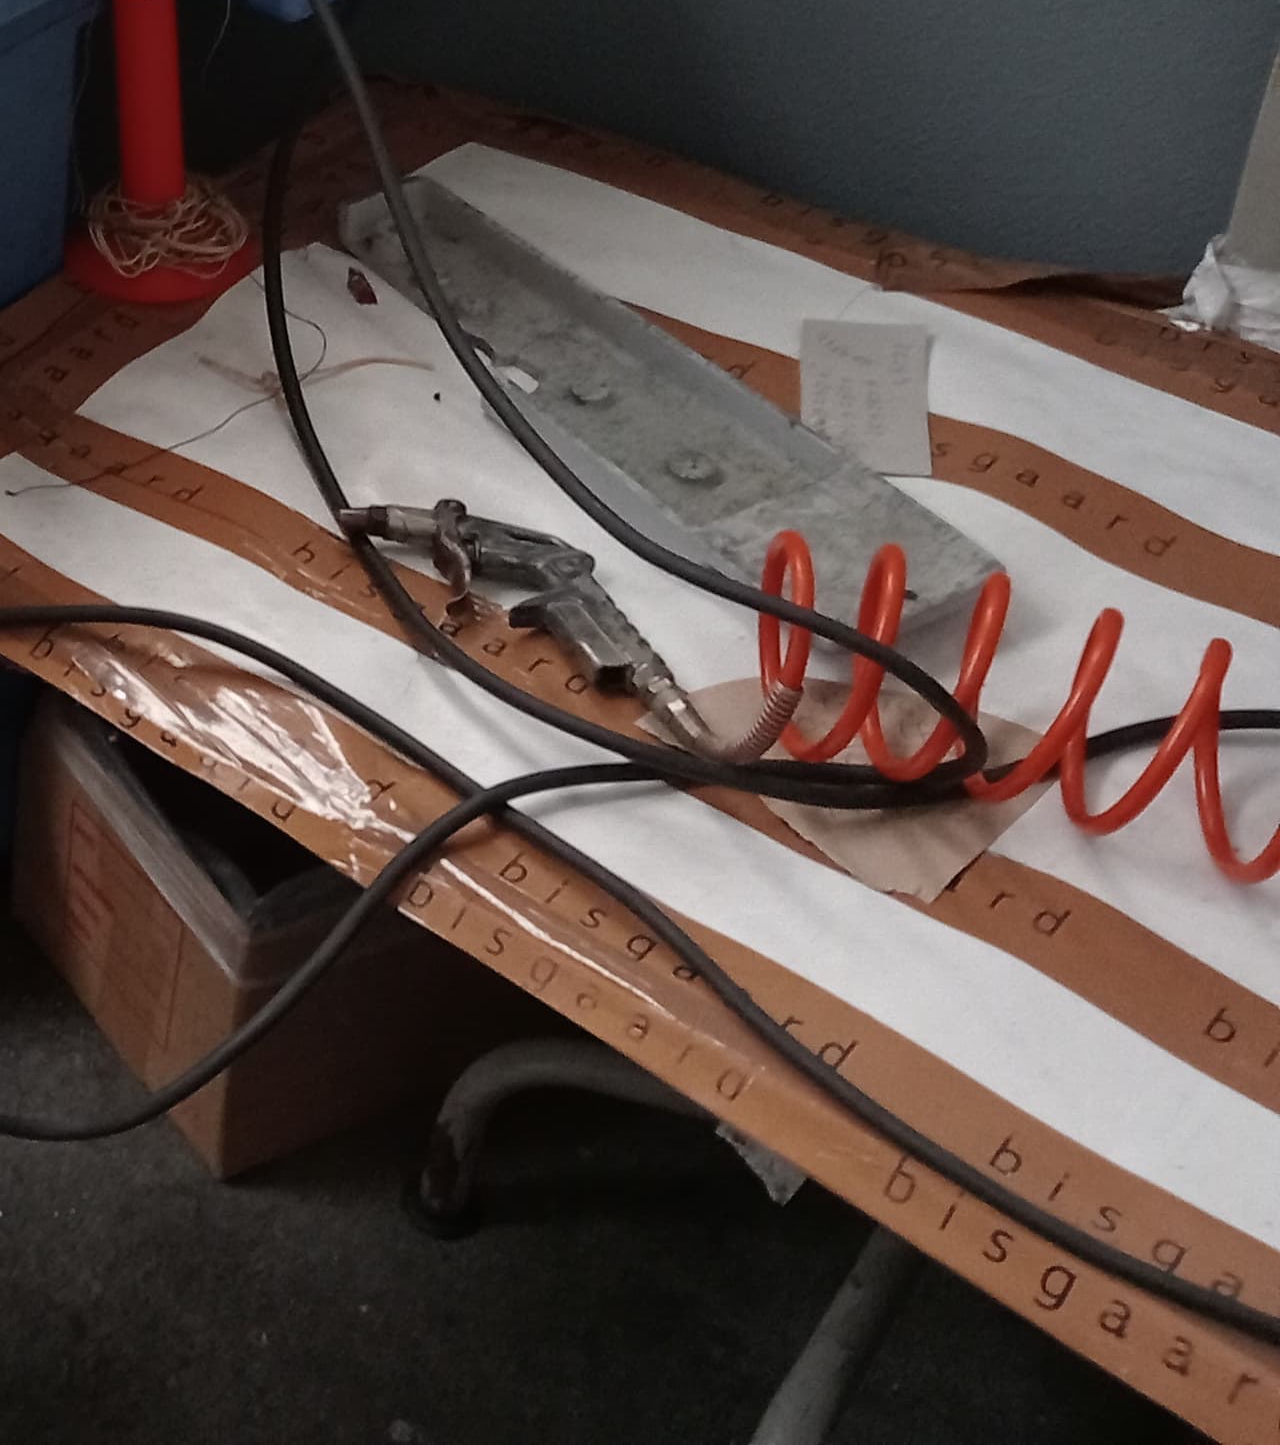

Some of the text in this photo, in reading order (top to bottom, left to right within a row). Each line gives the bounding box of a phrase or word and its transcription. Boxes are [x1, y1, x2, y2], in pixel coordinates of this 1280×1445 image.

[936, 442, 1178, 557] sgaard
[499, 852, 859, 1069] bisgard
[884, 1154, 1280, 1430] bisgaar
[989, 1134, 1245, 1300] bisga
